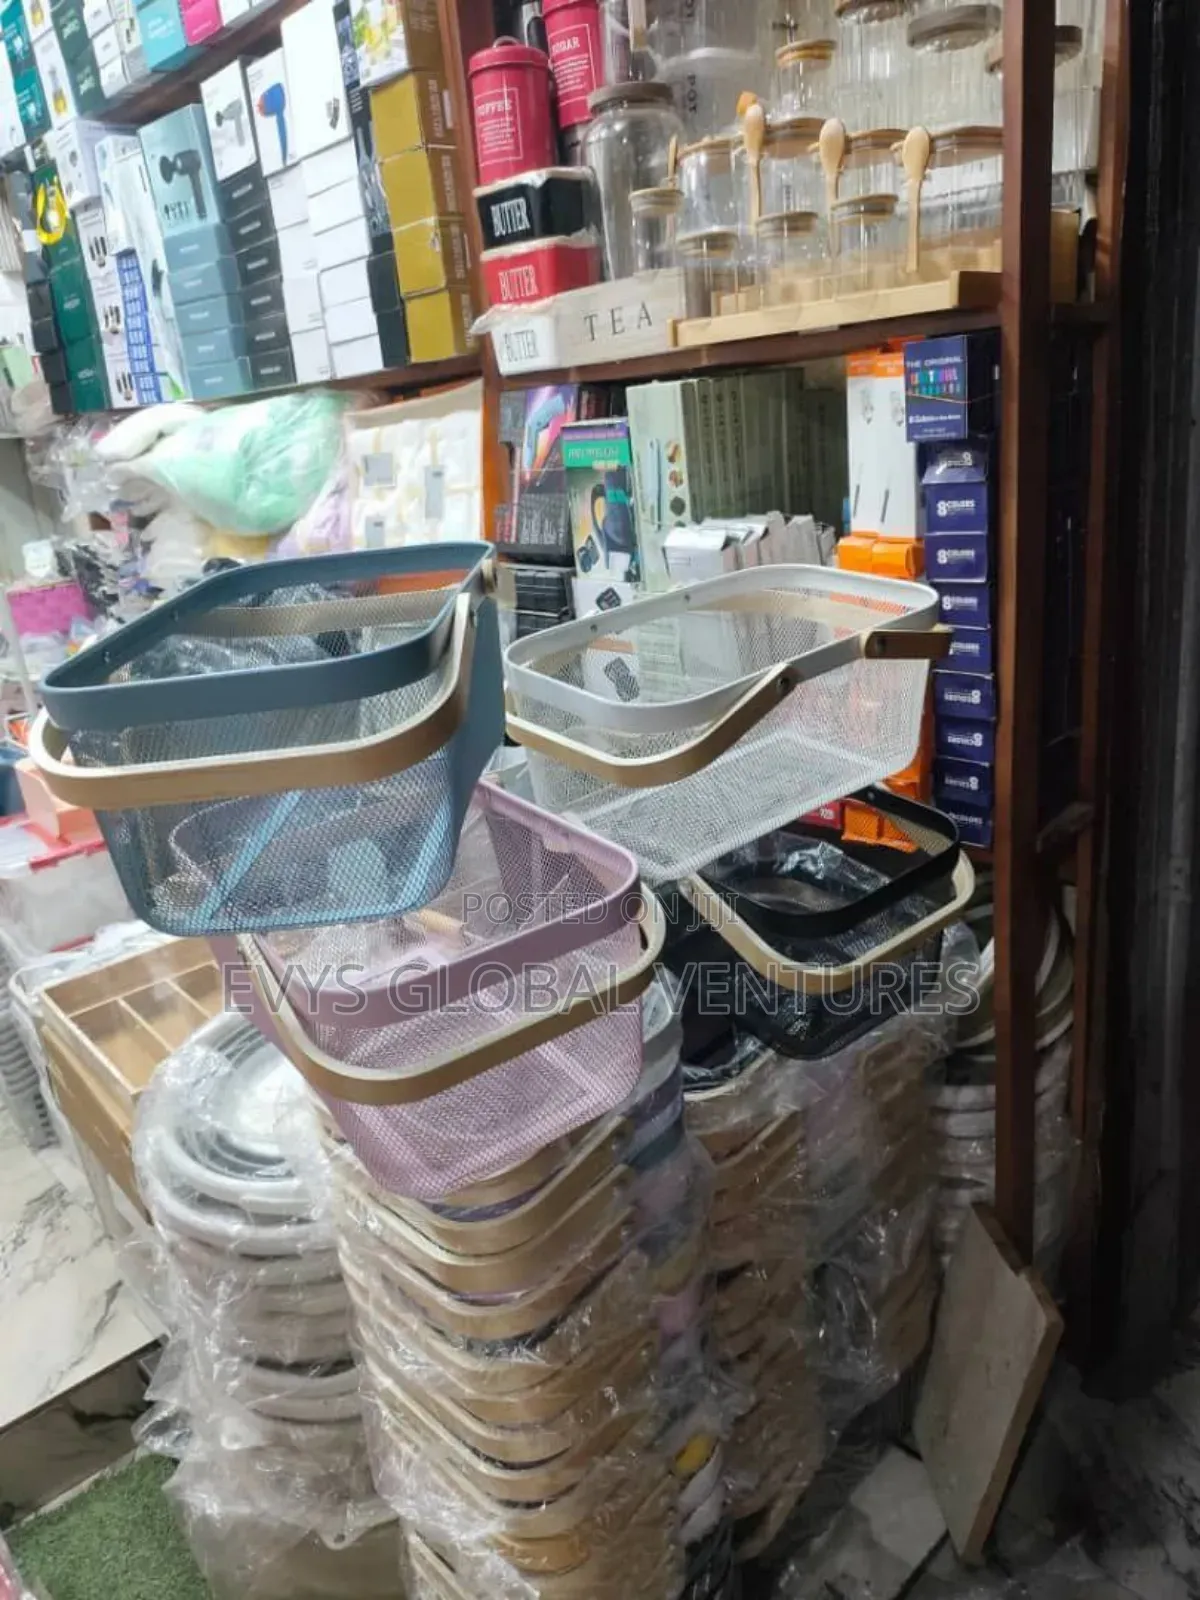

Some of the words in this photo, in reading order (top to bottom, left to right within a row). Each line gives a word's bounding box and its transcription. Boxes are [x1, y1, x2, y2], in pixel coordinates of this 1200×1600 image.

[490, 196, 531, 238] BUTTER
[498, 264, 540, 301] BUTTER
[583, 301, 653, 342] TEA
[503, 328, 540, 363] BUTTER
[936, 500, 948, 517] 8
[936, 548, 948, 565] 8
[942, 595, 952, 611] 8
